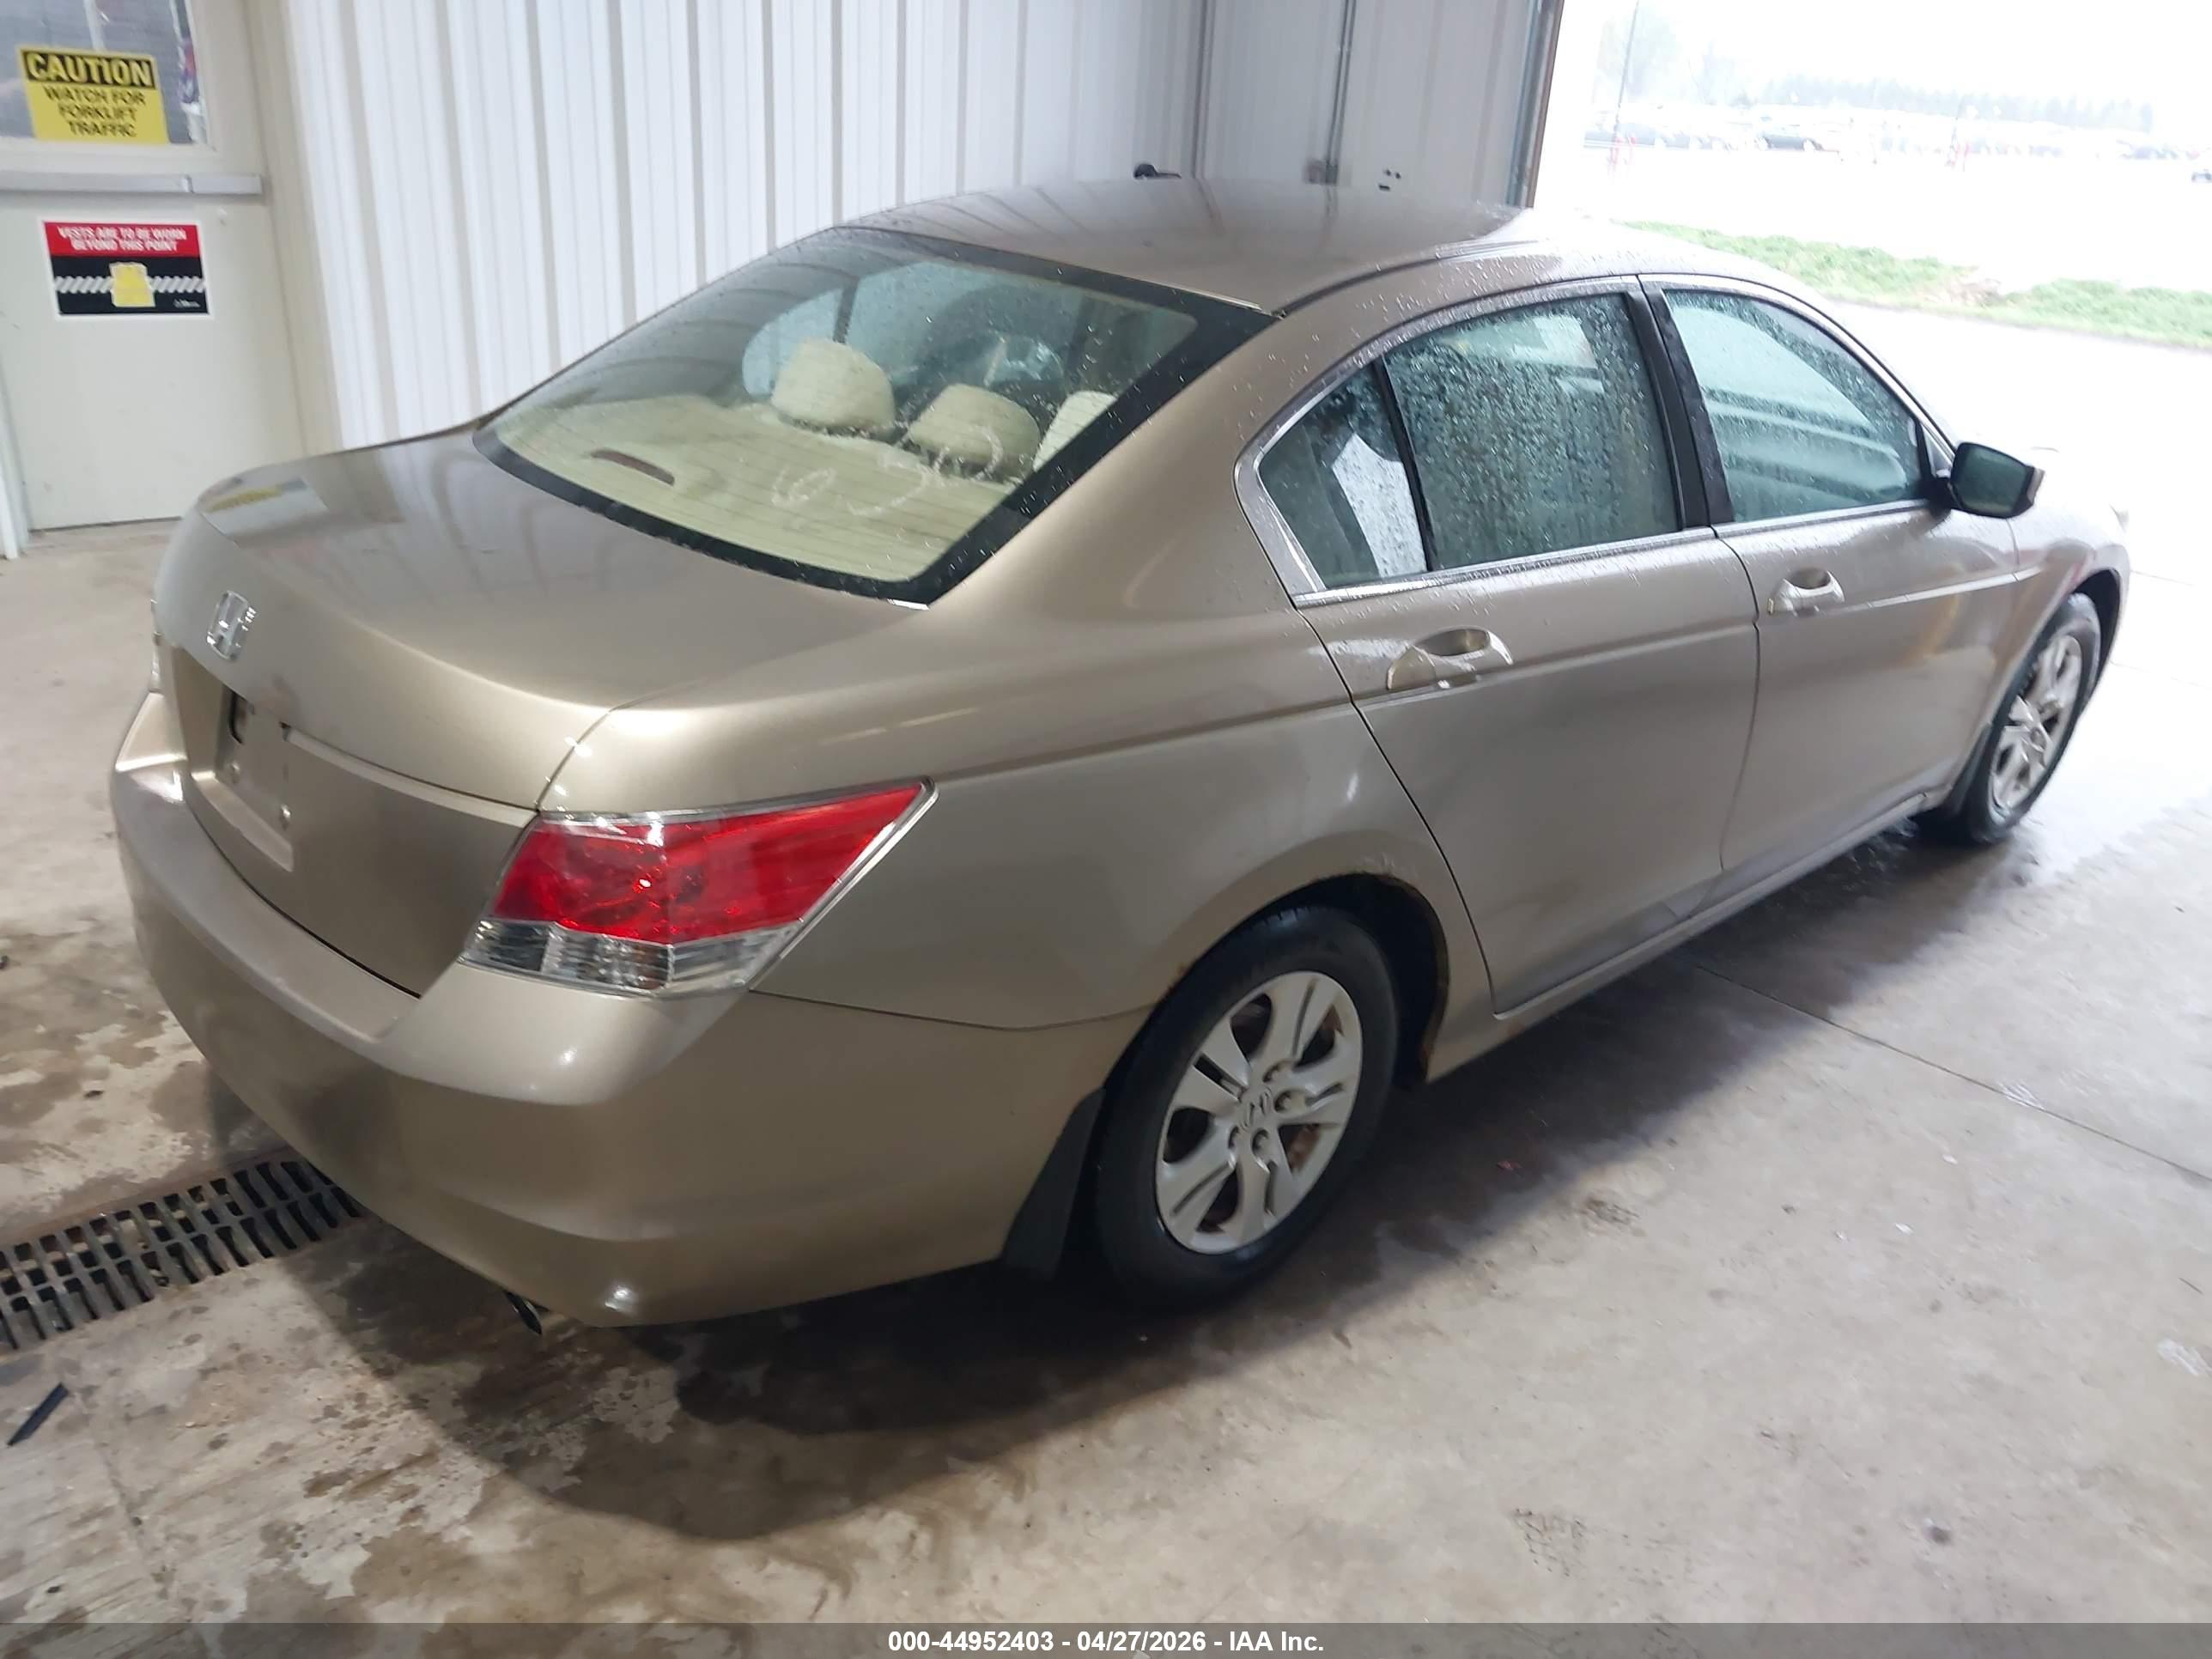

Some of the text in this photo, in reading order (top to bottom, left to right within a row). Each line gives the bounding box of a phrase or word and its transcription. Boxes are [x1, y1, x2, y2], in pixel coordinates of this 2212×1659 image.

[26, 52, 152, 87] CAUTION
[44, 85, 146, 106] WATCH FOR
[58, 102, 137, 121] FORKLIFT
[67, 119, 137, 137] TRAFFIC
